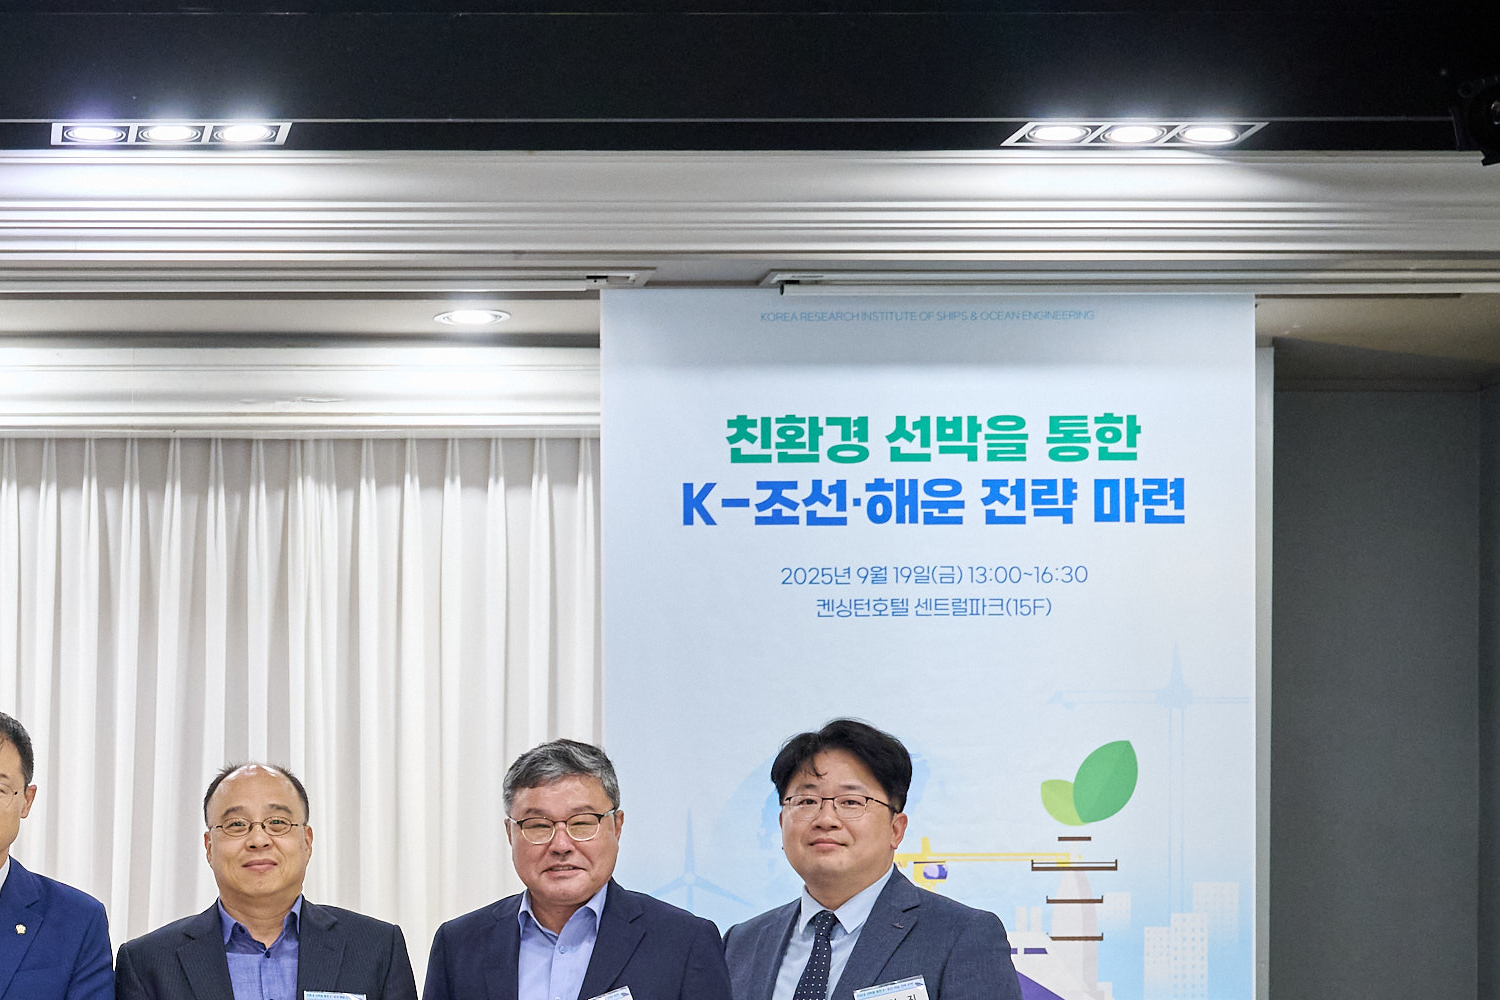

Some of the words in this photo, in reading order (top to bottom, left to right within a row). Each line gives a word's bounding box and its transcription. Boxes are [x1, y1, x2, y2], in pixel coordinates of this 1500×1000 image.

[760, 311, 797, 321] KOREA
[800, 311, 860, 321] RESEARCH
[862, 311, 917, 321] INSTITUTE
[919, 311, 935, 321] OF
[937, 311, 967, 321] SHIPS
[970, 311, 977, 321] &
[980, 311, 1020, 321] OCEAN
[1022, 311, 1095, 321] ENGINEERING
[726, 414, 870, 464] 친환경
[885, 414, 1029, 463] 선박을
[1046, 413, 1142, 462] 통한
[980, 478, 1078, 525] 전략
[1094, 478, 1186, 525] 마련
[780, 566, 851, 586] 2025년
[856, 566, 888, 585] 9월
[893, 565, 963, 585] 19일(금)
[968, 566, 1089, 585] 13:00~16:30
[816, 597, 909, 618] 켄싱턴호텔
[914, 597, 1052, 618] 센트럴파크(15F)
